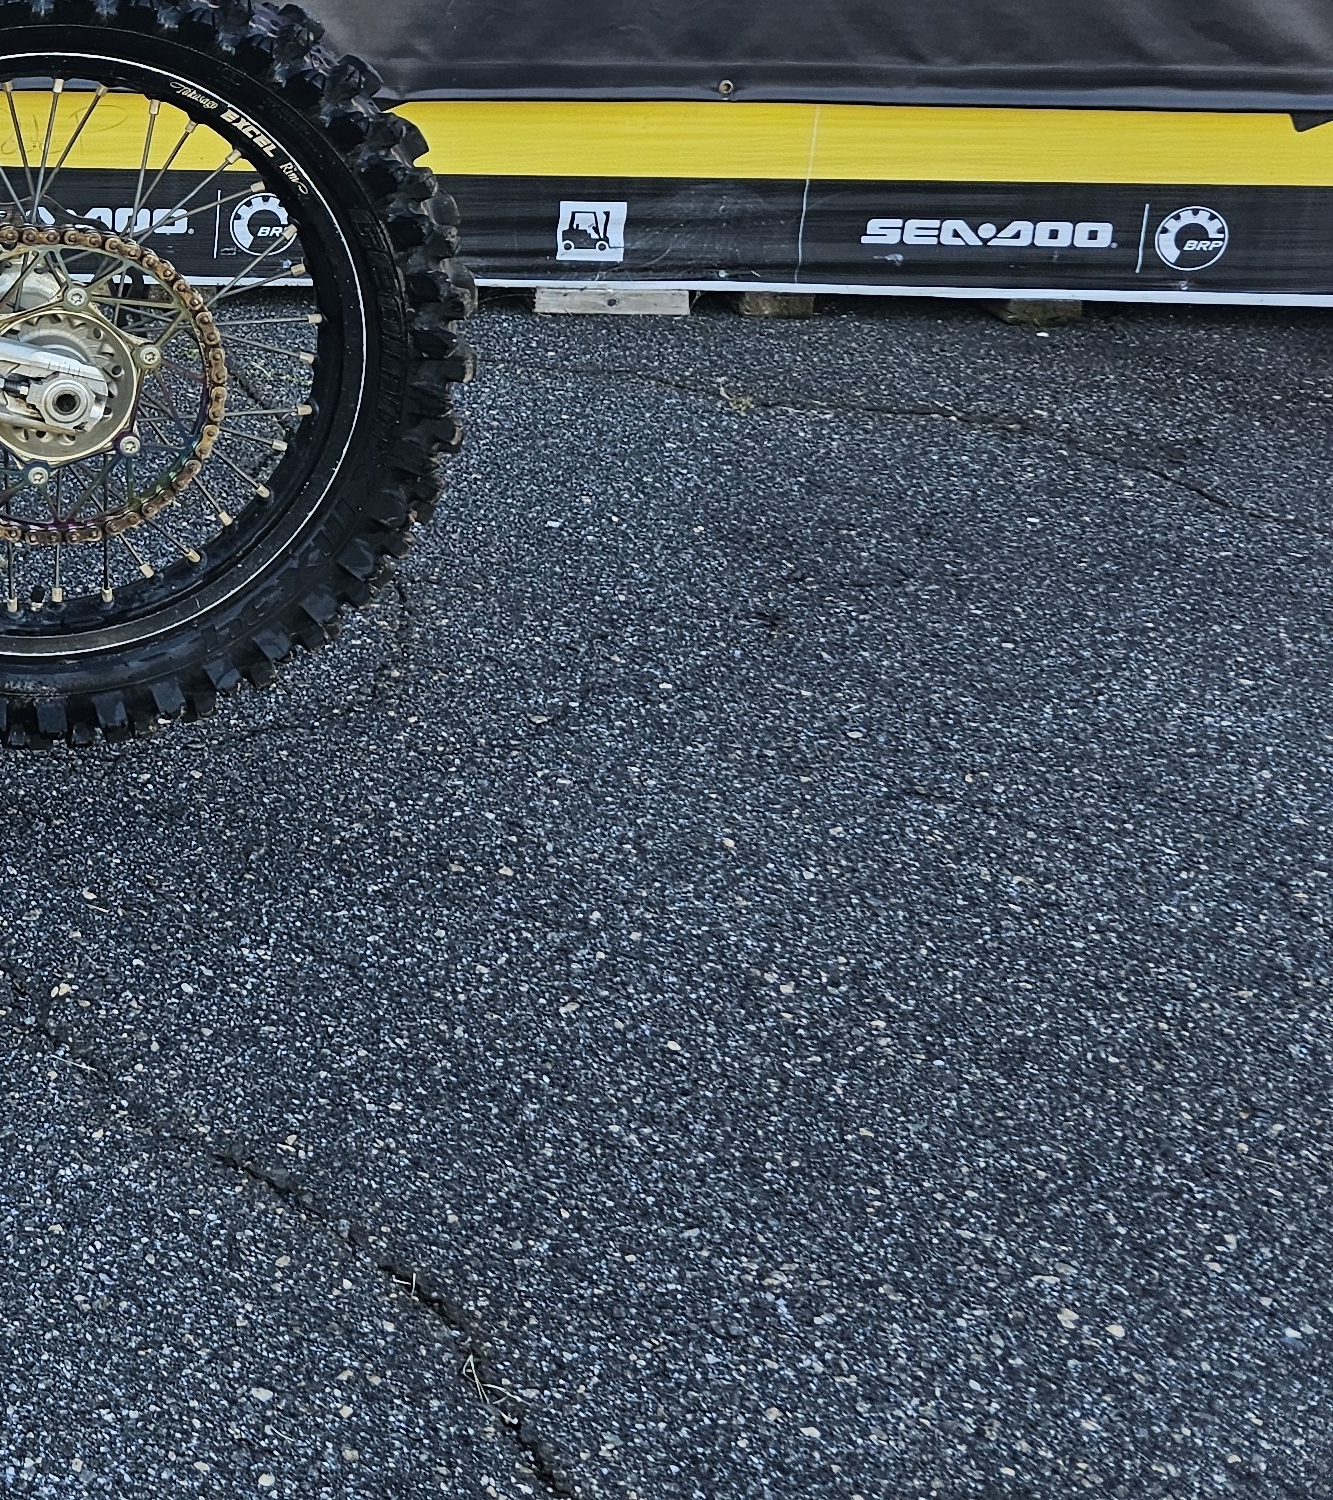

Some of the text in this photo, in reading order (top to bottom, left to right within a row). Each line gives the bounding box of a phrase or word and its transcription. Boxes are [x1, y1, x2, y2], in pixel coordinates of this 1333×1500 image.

[220, 109, 279, 158] EXCEL
[279, 161, 309, 195] Rim
[257, 226, 287, 238] BR
[1182, 240, 1226, 252] BRP
